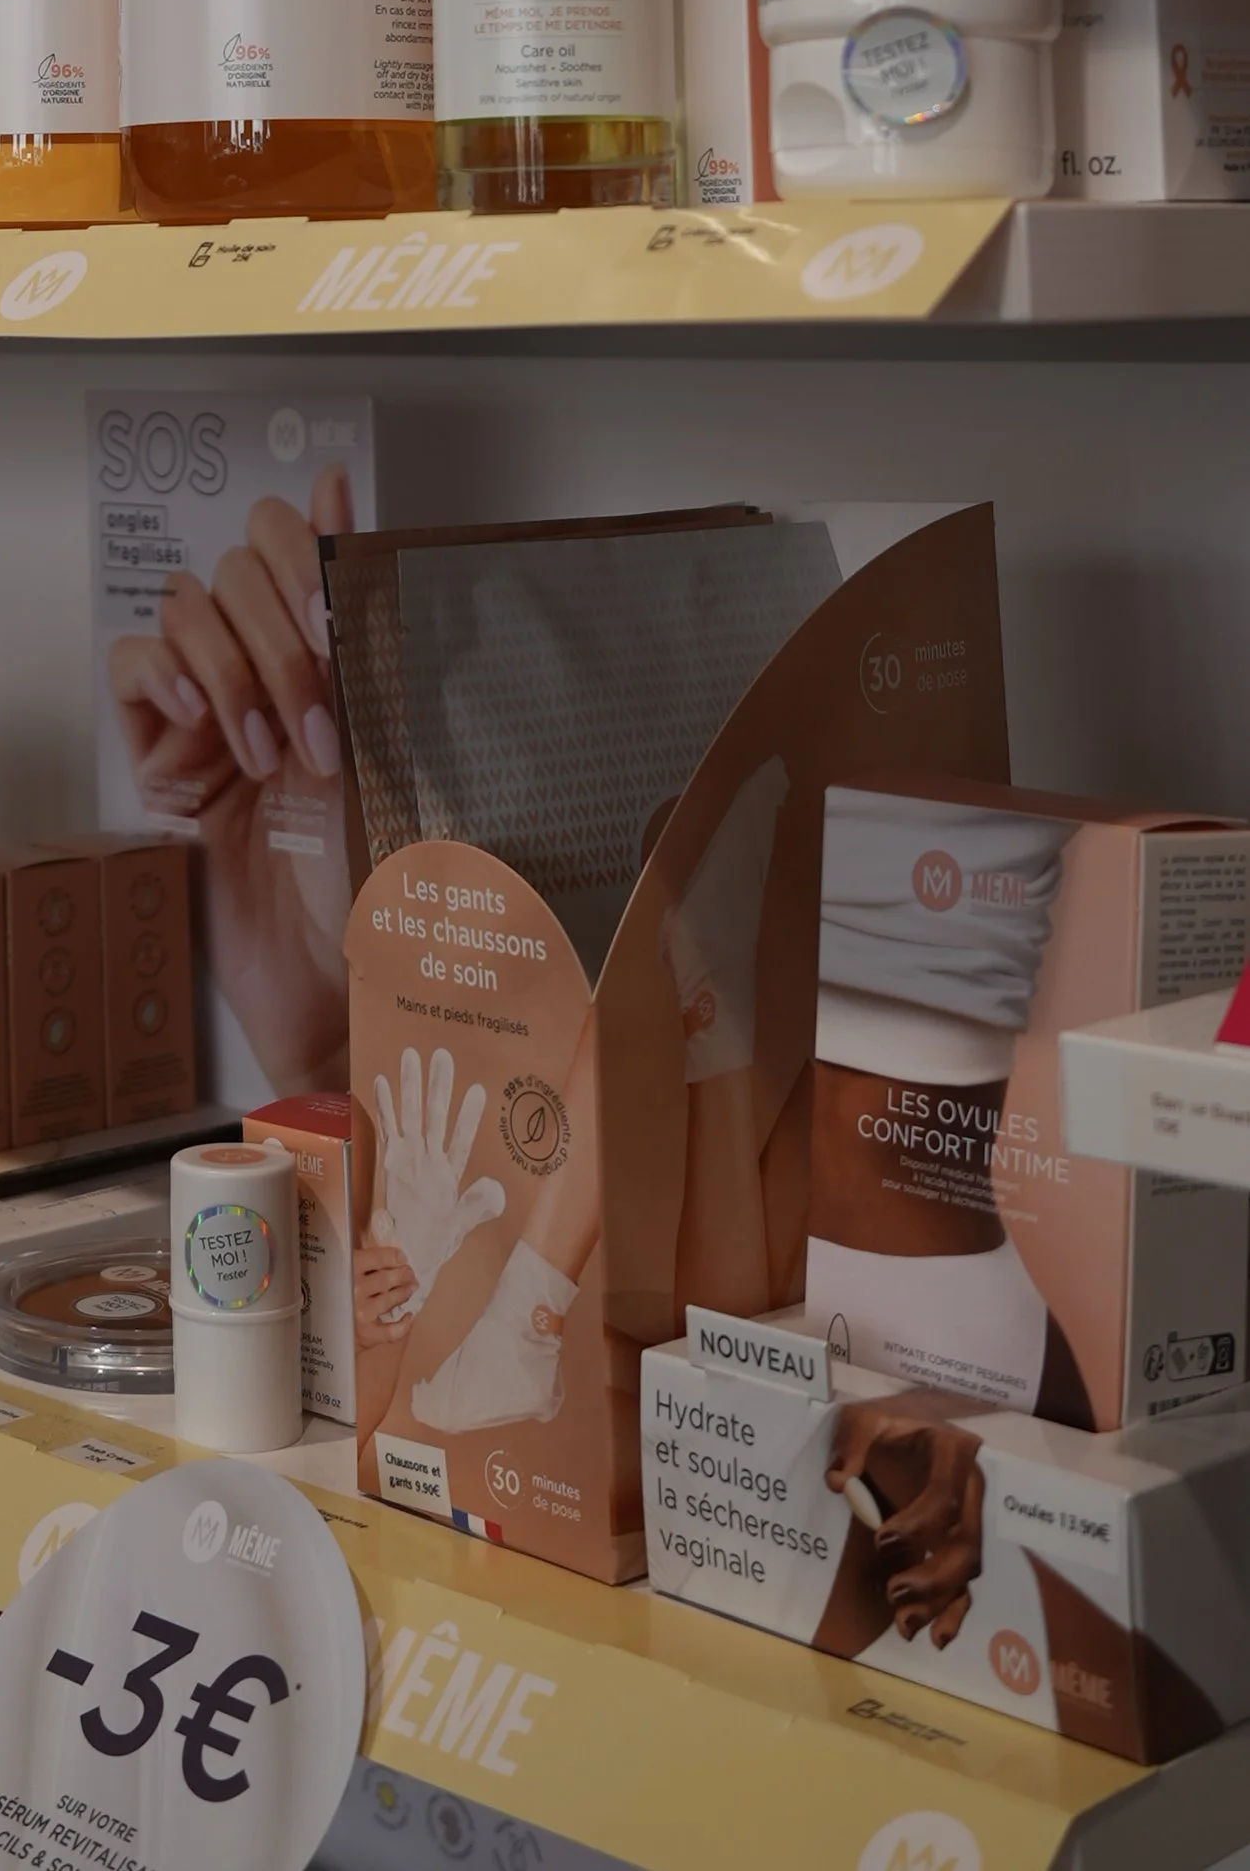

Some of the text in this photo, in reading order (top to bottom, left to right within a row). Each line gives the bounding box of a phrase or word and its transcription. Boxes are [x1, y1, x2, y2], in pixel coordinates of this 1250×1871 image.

[566, 6, 611, 17] PRENDS
[236, 45, 271, 60] 96%
[521, 43, 576, 58] Care oil
[860, 30, 931, 68] TESTEZ
[51, 64, 84, 78] 96%
[558, 61, 603, 73] Soothes
[226, 80, 272, 89] NATURELLE
[41, 96, 84, 105] NATURELLE
[709, 159, 740, 176] 99%
[1088, 153, 1123, 176] oz.
[295, 231, 522, 312] MÊME
[99, 409, 228, 497] SOS
[106, 510, 161, 533] ongles
[107, 539, 184, 566] fragilisés
[915, 638, 967, 663] minutes
[868, 653, 902, 692] 30
[917, 668, 968, 694] de pose
[403, 871, 506, 916] Les gants
[371, 906, 548, 962] et les chaussons
[419, 950, 499, 993] de soin
[396, 994, 530, 1037] Mains et pieds fragilisés
[503, 1075, 525, 1101] 99%
[887, 1086, 1040, 1143] LES OVULES
[857, 1113, 1071, 1186] CONFORT INTIME
[199, 1229, 255, 1251] TESTEZ
[210, 1251, 240, 1269] MOI
[217, 1269, 249, 1282] Tester
[699, 1328, 815, 1382] NOUVEAU
[884, 1339, 927, 1363] INTIMATE
[928, 1352, 974, 1374] COMFORT
[656, 1389, 755, 1447] Hydrate
[384, 1452, 443, 1479] Chaussons et
[491, 1463, 521, 1496] 30
[655, 1439, 788, 1503] et soulage
[388, 1474, 442, 1498] gants 9.90€
[531, 1473, 582, 1502] minutes
[532, 1493, 582, 1523] de pose
[657, 1476, 829, 1561] la sécheresse
[1003, 1494, 1055, 1524] Ovules
[227, 1522, 282, 1571] MÊME
[659, 1528, 765, 1584] vaginale
[45, 1609, 290, 1804] -3€
[56, 1794, 138, 1844] SUR VOTRE
[31, 1849, 47, 1868] &
